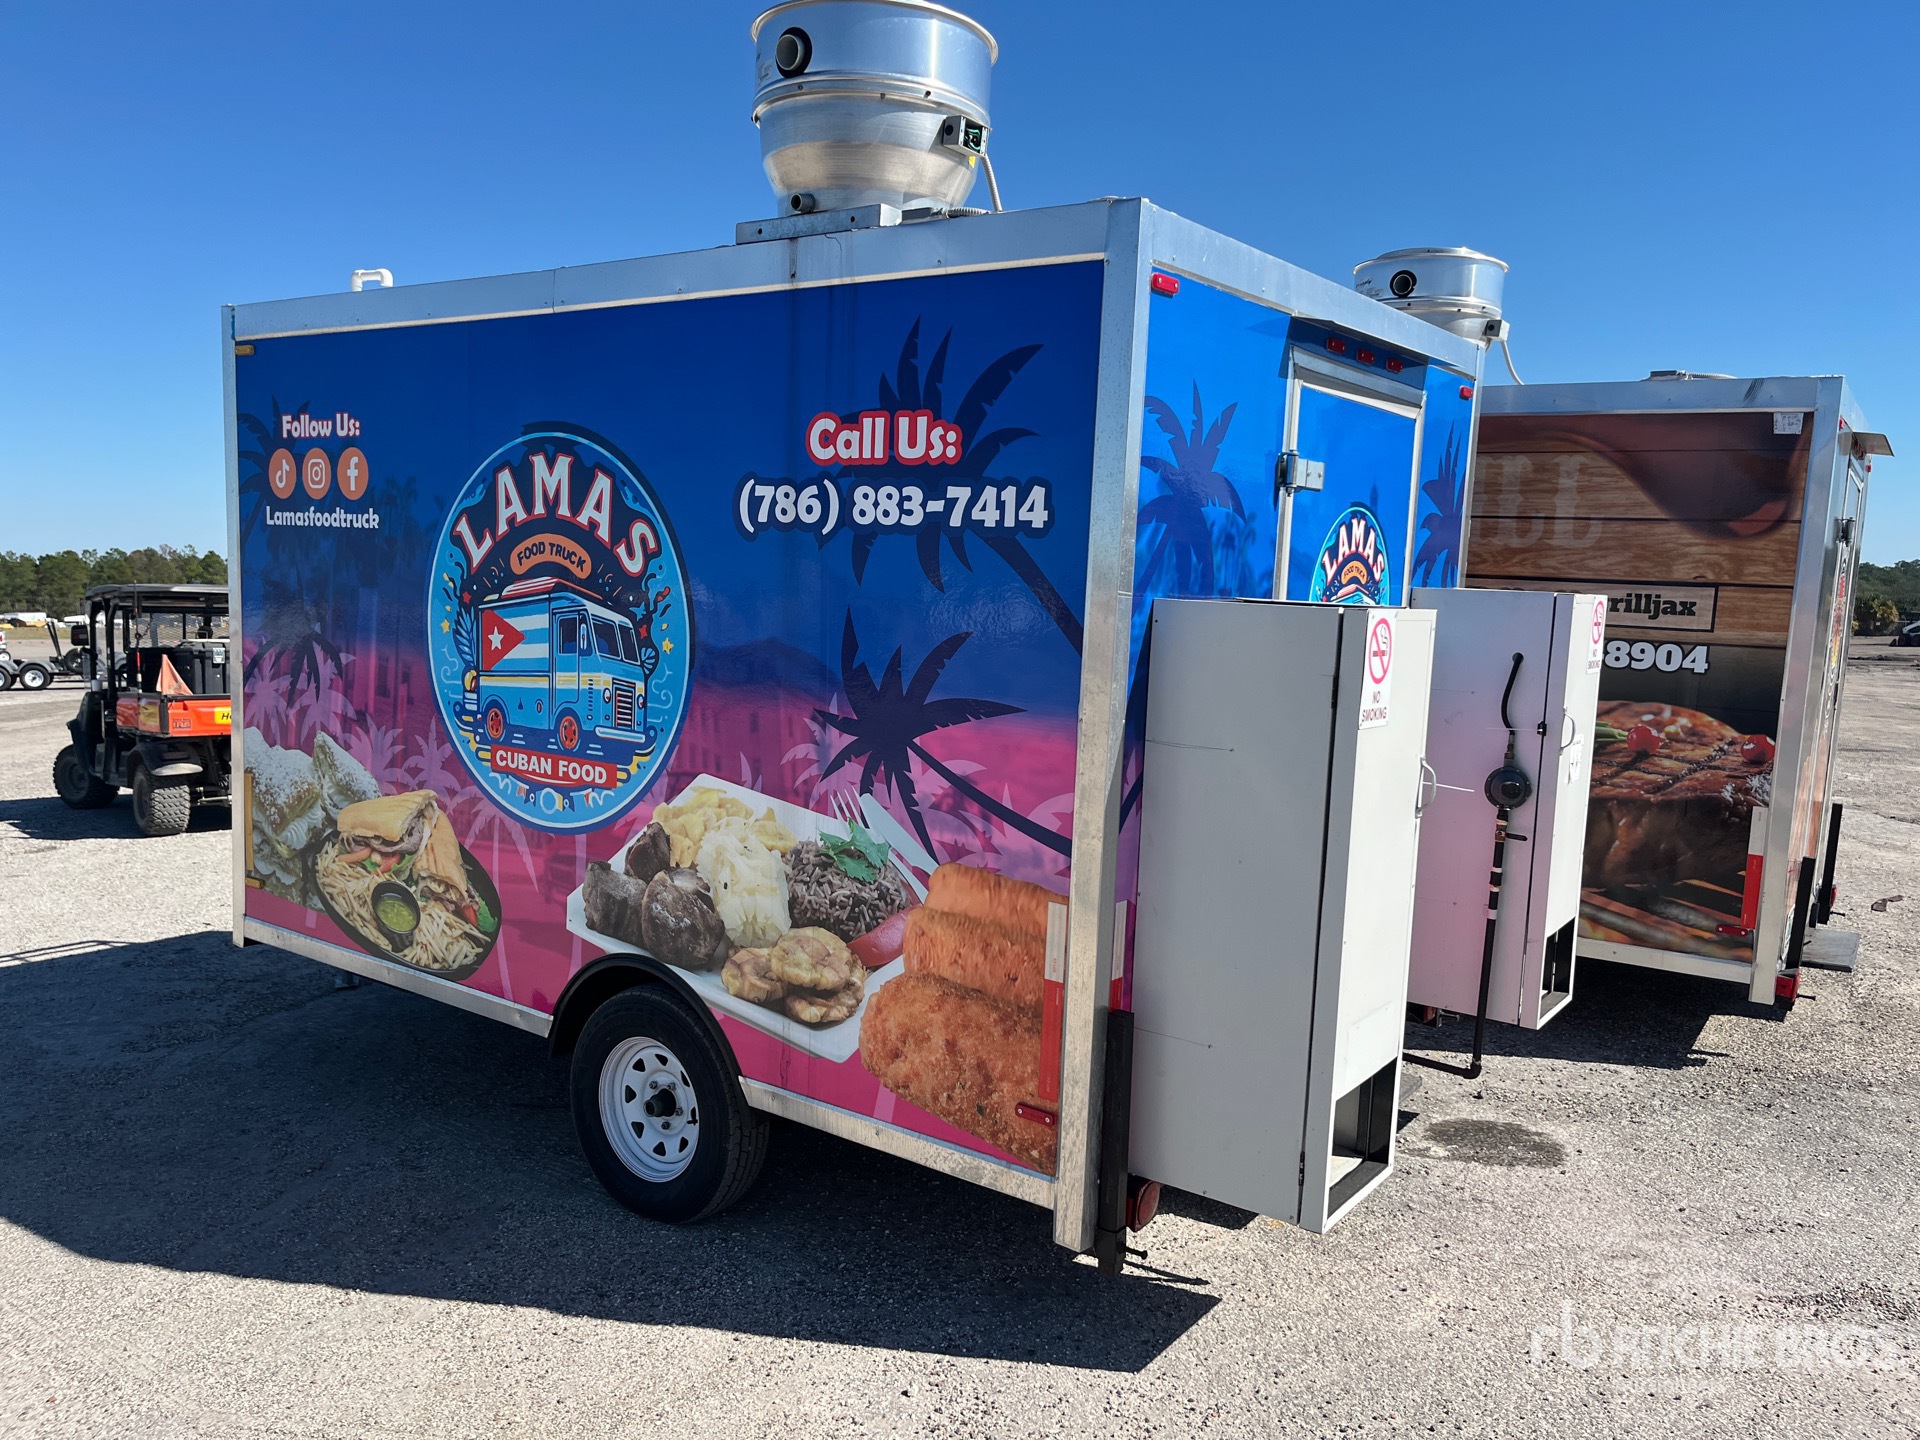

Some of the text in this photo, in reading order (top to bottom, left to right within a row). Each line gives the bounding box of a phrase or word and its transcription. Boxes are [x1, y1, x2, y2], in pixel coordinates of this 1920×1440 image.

[281, 413, 360, 438] Follow Us:
[809, 415, 958, 460] Call Us:
[266, 505, 380, 529] Lamasfoodtruck
[453, 452, 658, 577] LAMAS
[739, 478, 1049, 535] (786) 883-7414
[516, 541, 587, 573] FOOD TRUCK
[1322, 518, 1385, 585] LAMAS
[1607, 592, 1697, 620] rilljax
[1602, 640, 1709, 674] 8904
[1372, 690, 1381, 704] NO
[1361, 706, 1388, 722] SMOKING
[495, 749, 607, 784] CUBAN FOOD
